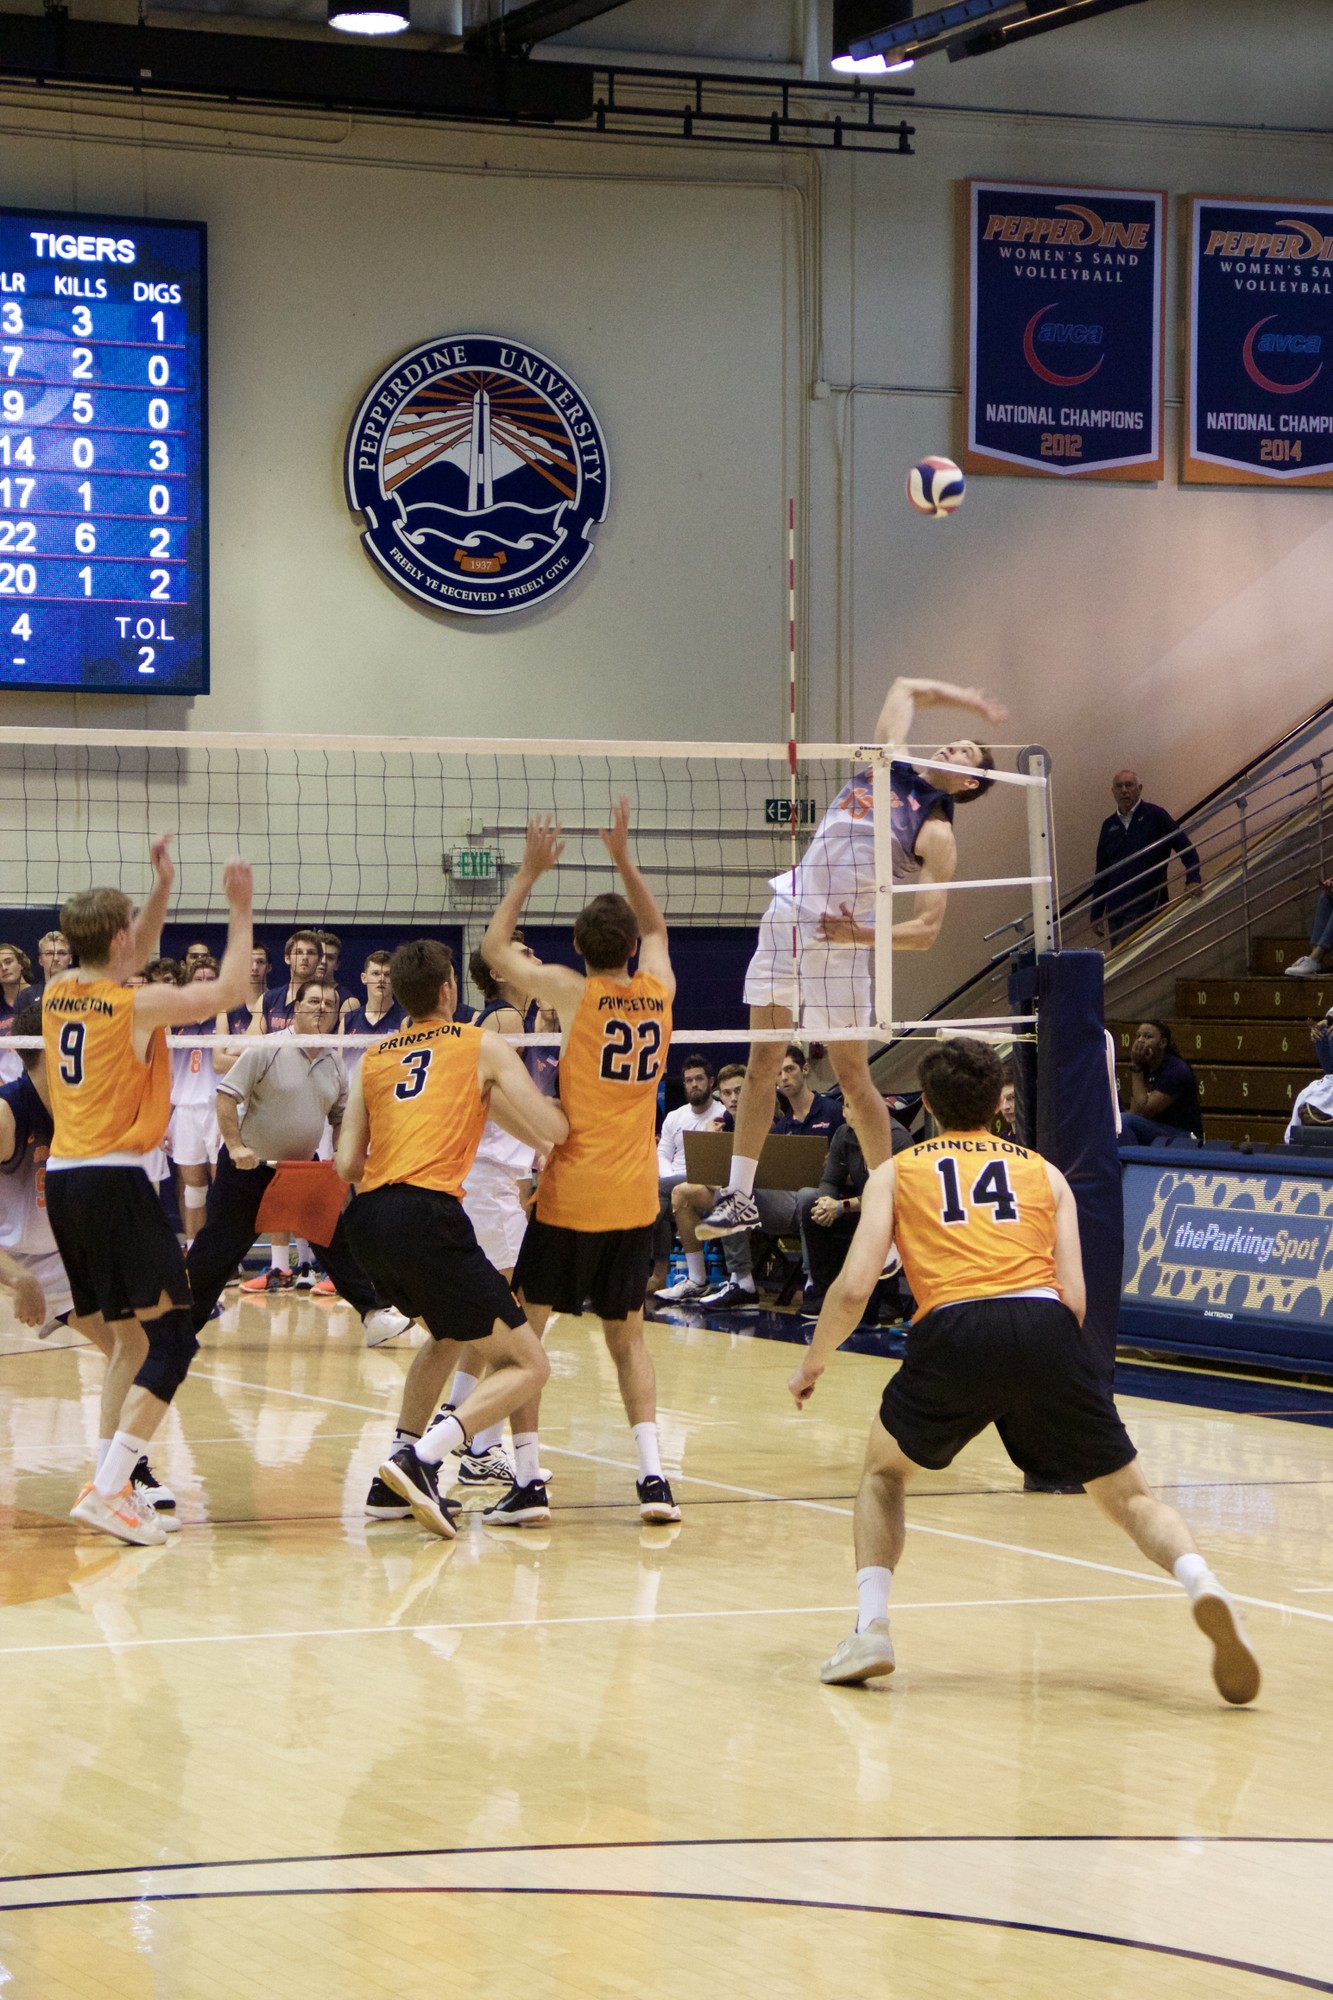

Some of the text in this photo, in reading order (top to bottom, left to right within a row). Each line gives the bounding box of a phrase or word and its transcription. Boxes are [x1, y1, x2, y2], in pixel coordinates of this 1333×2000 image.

[983, 204, 1150, 249] PEPPERDINE
[1203, 220, 1333, 261] PEPPERDI
[31, 232, 135, 263] TIGERS
[1000, 247, 1139, 266] WOMEN'S SAND
[1014, 265, 1123, 283] VOLLEYBALL
[1220, 261, 1302, 276] WOMEN'S
[0, 272, 181, 304] LR KILLS DIGS
[3, 302, 164, 340] 3 3 1
[1038, 322, 1104, 344] avca
[1257, 333, 1322, 353] avca
[3, 346, 169, 386] 7 2 0
[3, 390, 169, 429] 9 5 0
[358, 345, 601, 484] PEPPERDINE UNIVERSITY
[986, 404, 1144, 430] NATIONAL CHAMPIONS
[1207, 412, 1275, 431] NATIONAL
[0, 435, 169, 470] 14 0 3
[1040, 433, 1082, 457] 2012
[1260, 439, 1302, 461] 2014
[0, 477, 169, 515] 17 1 0
[0, 521, 170, 558] 22 6 2
[389, 546, 571, 602] FREELY YE RECEIVED FREELY GIVE
[471, 560, 492, 570] 1937
[0, 563, 170, 599] 20 1 2
[11, 613, 174, 641] 4 T.O.L
[138, 647, 155, 673] 2
[461, 852, 491, 876] EXIT
[598, 995, 664, 1011] PRINCETON
[1198, 992, 1207, 1005] 10
[1318, 992, 1324, 1006] 7
[378, 1025, 461, 1054] PRINCETON
[599, 1018, 661, 1084] 22
[1121, 1034, 1288, 1051] 10 8 7 6
[59, 1020, 86, 1088] 9
[190, 1049, 202, 1074] 8
[394, 1048, 433, 1101] 3
[1243, 1083, 1249, 1096] 5
[1286, 1084, 1292, 1099] 4
[914, 1140, 1028, 1160] PRINCETON
[935, 1155, 1020, 1226] 14
